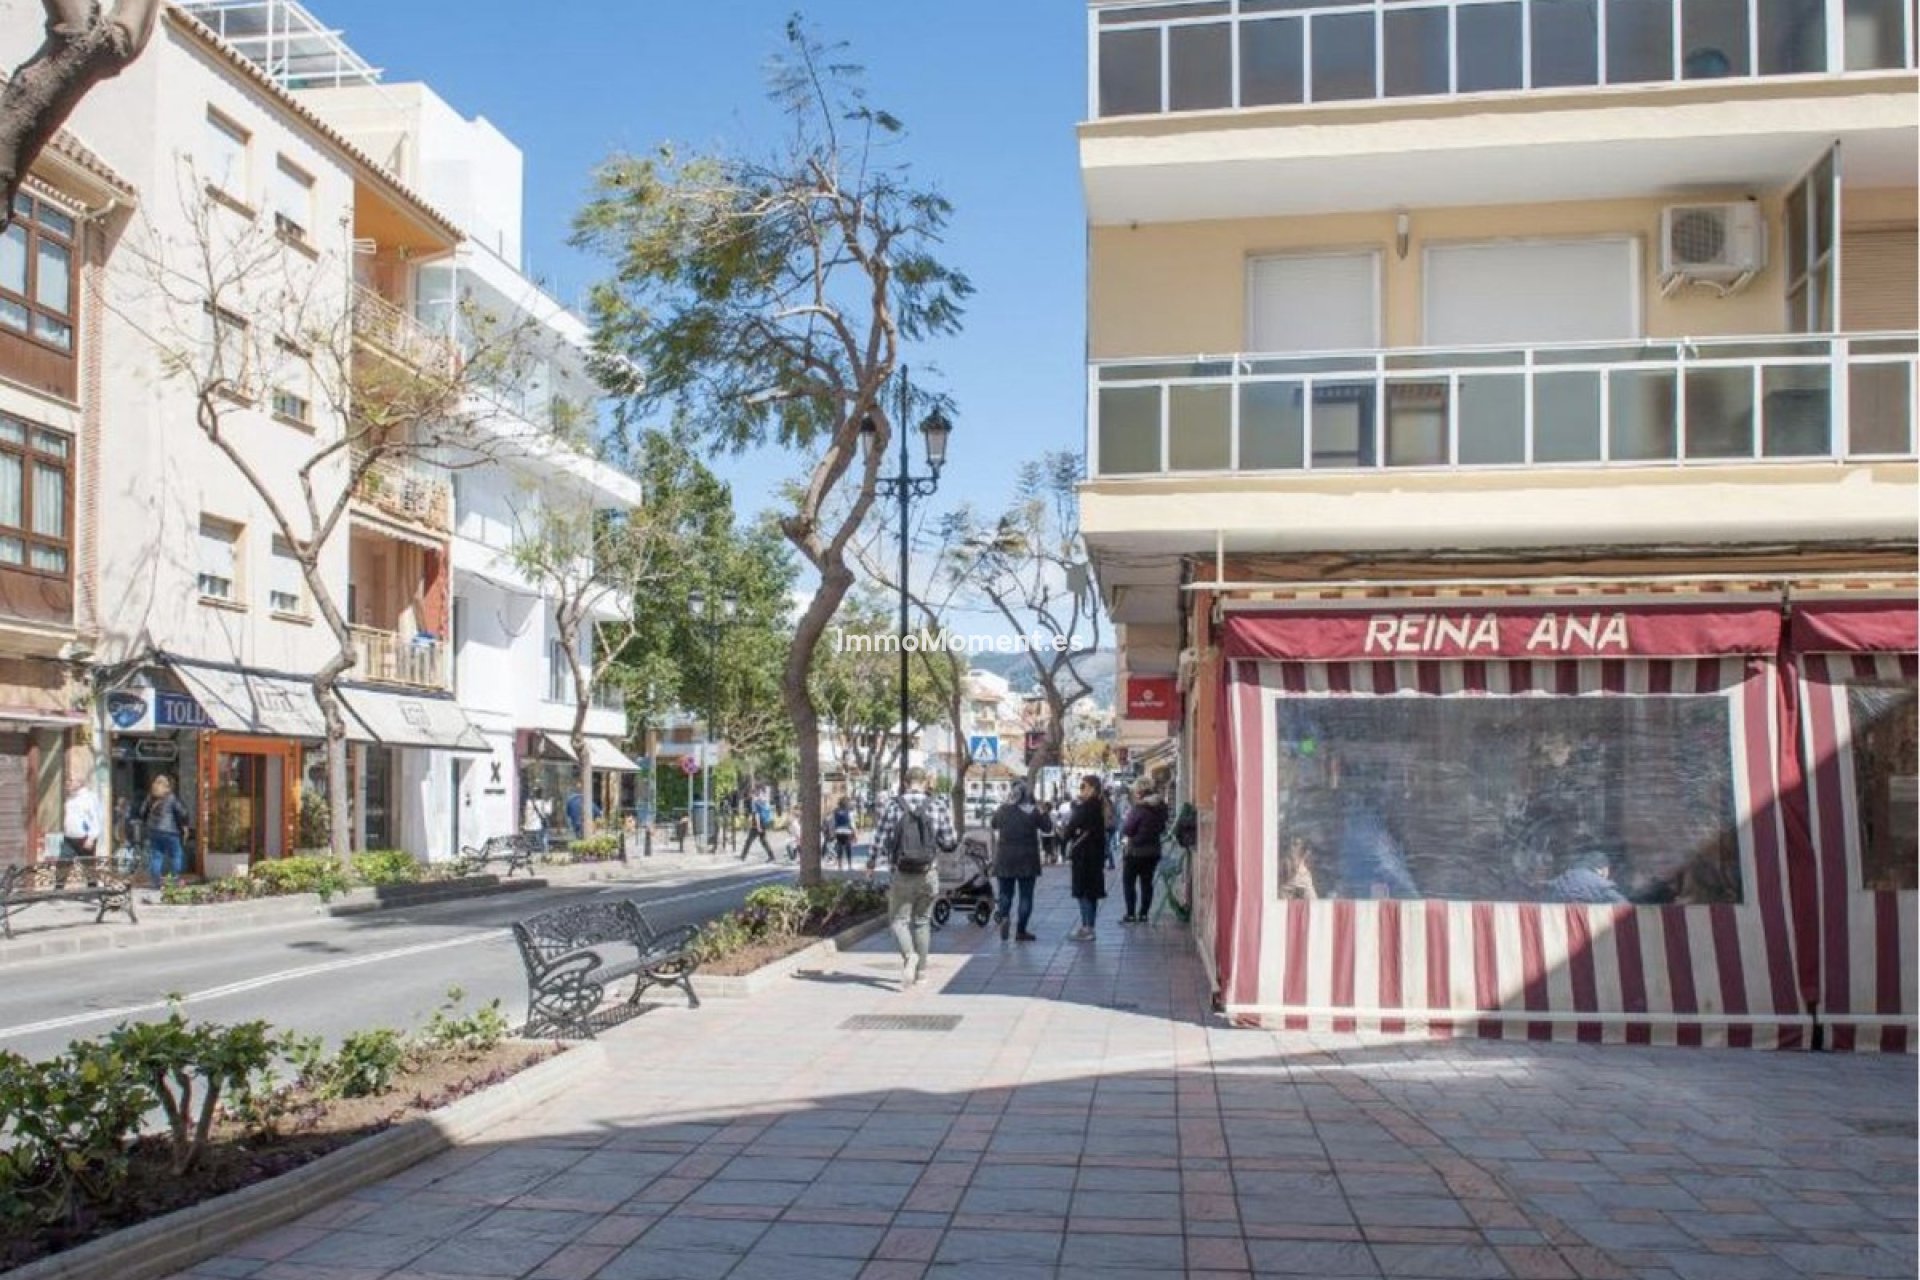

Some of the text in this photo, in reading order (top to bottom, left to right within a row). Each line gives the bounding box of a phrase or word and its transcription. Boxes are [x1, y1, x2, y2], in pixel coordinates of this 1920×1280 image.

[1364, 611, 1630, 653] REINA ANA
[164, 700, 212, 725] TOLD
